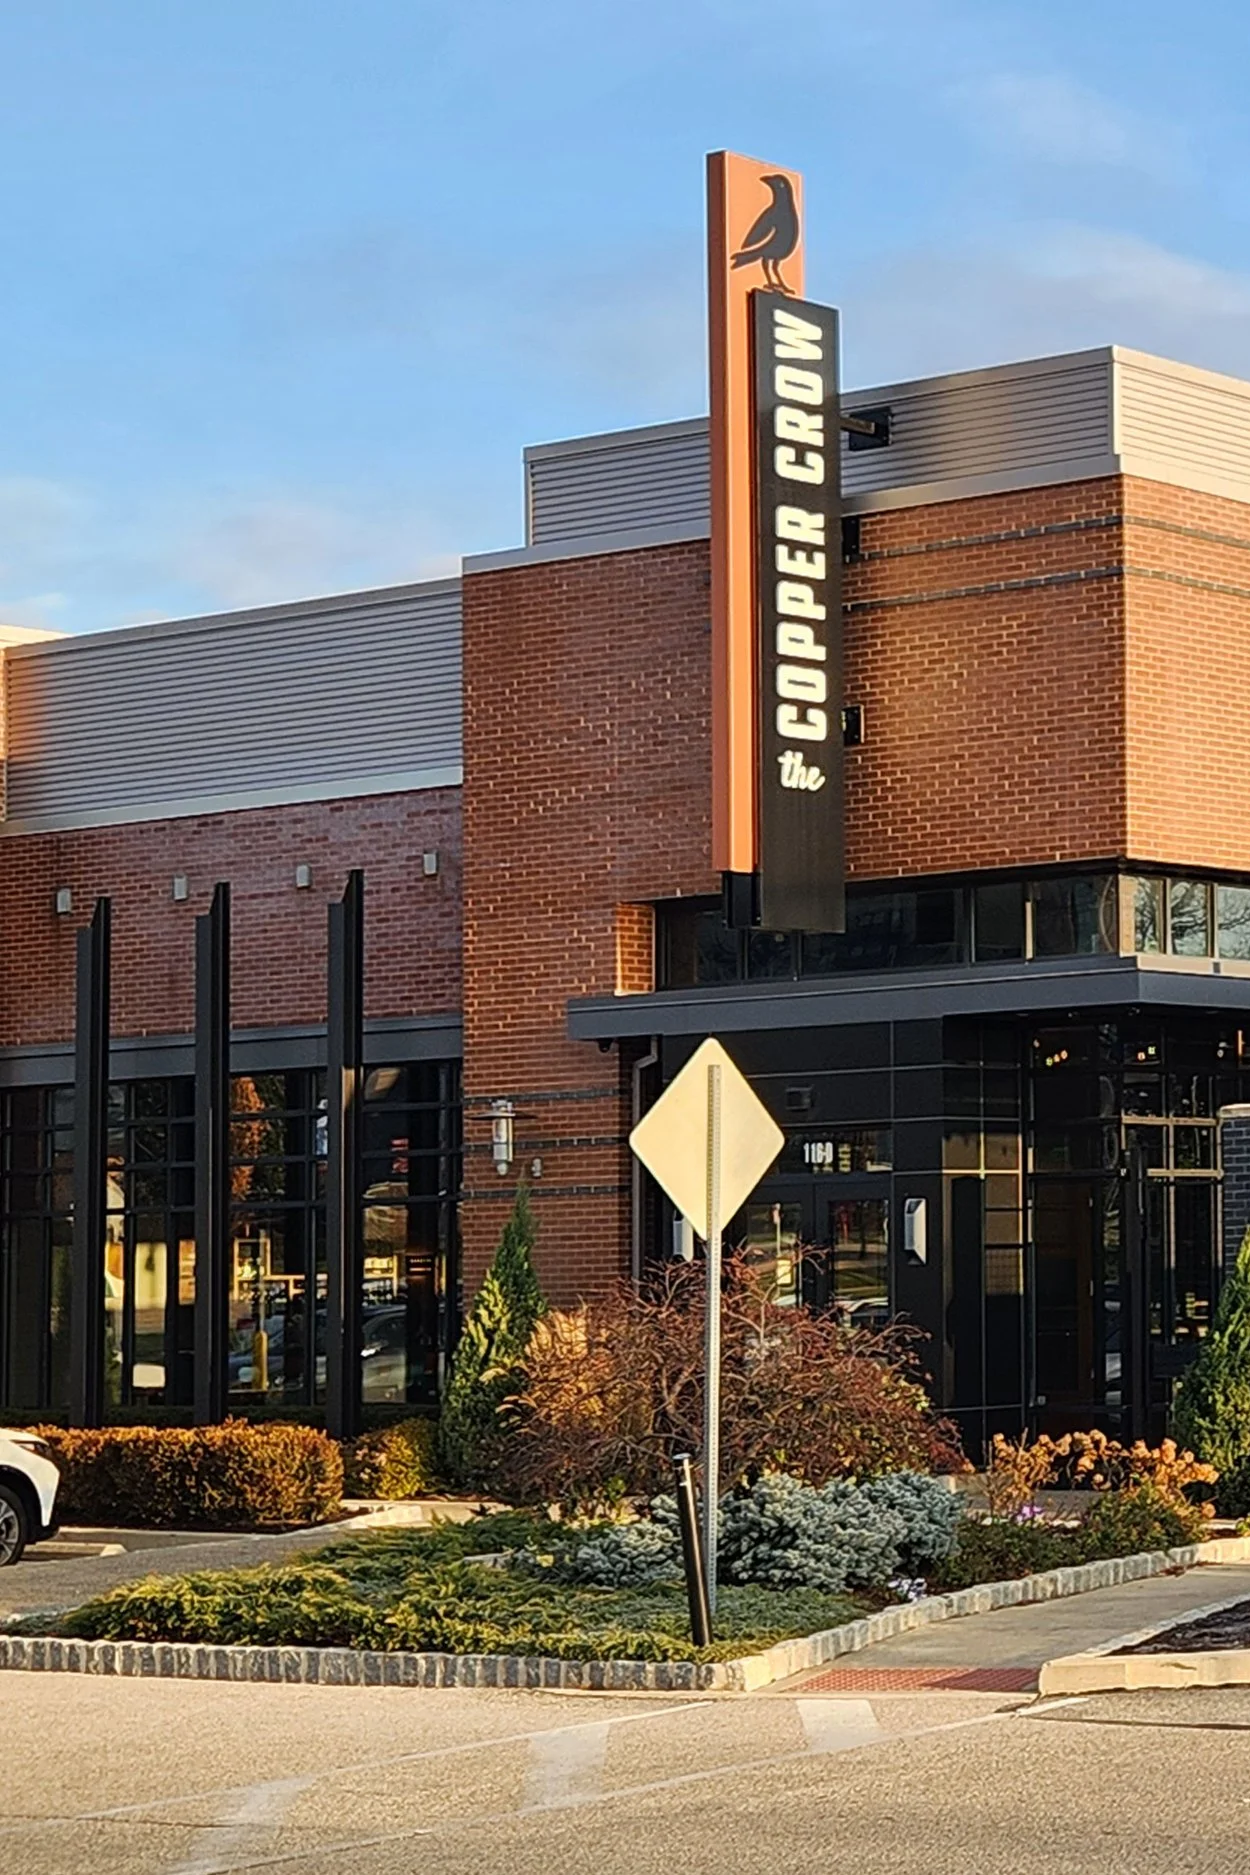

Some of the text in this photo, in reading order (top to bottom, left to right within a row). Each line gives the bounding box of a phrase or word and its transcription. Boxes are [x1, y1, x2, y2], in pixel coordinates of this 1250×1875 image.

[774, 309, 827, 741] COPPER CROW
[777, 750, 826, 791] the
